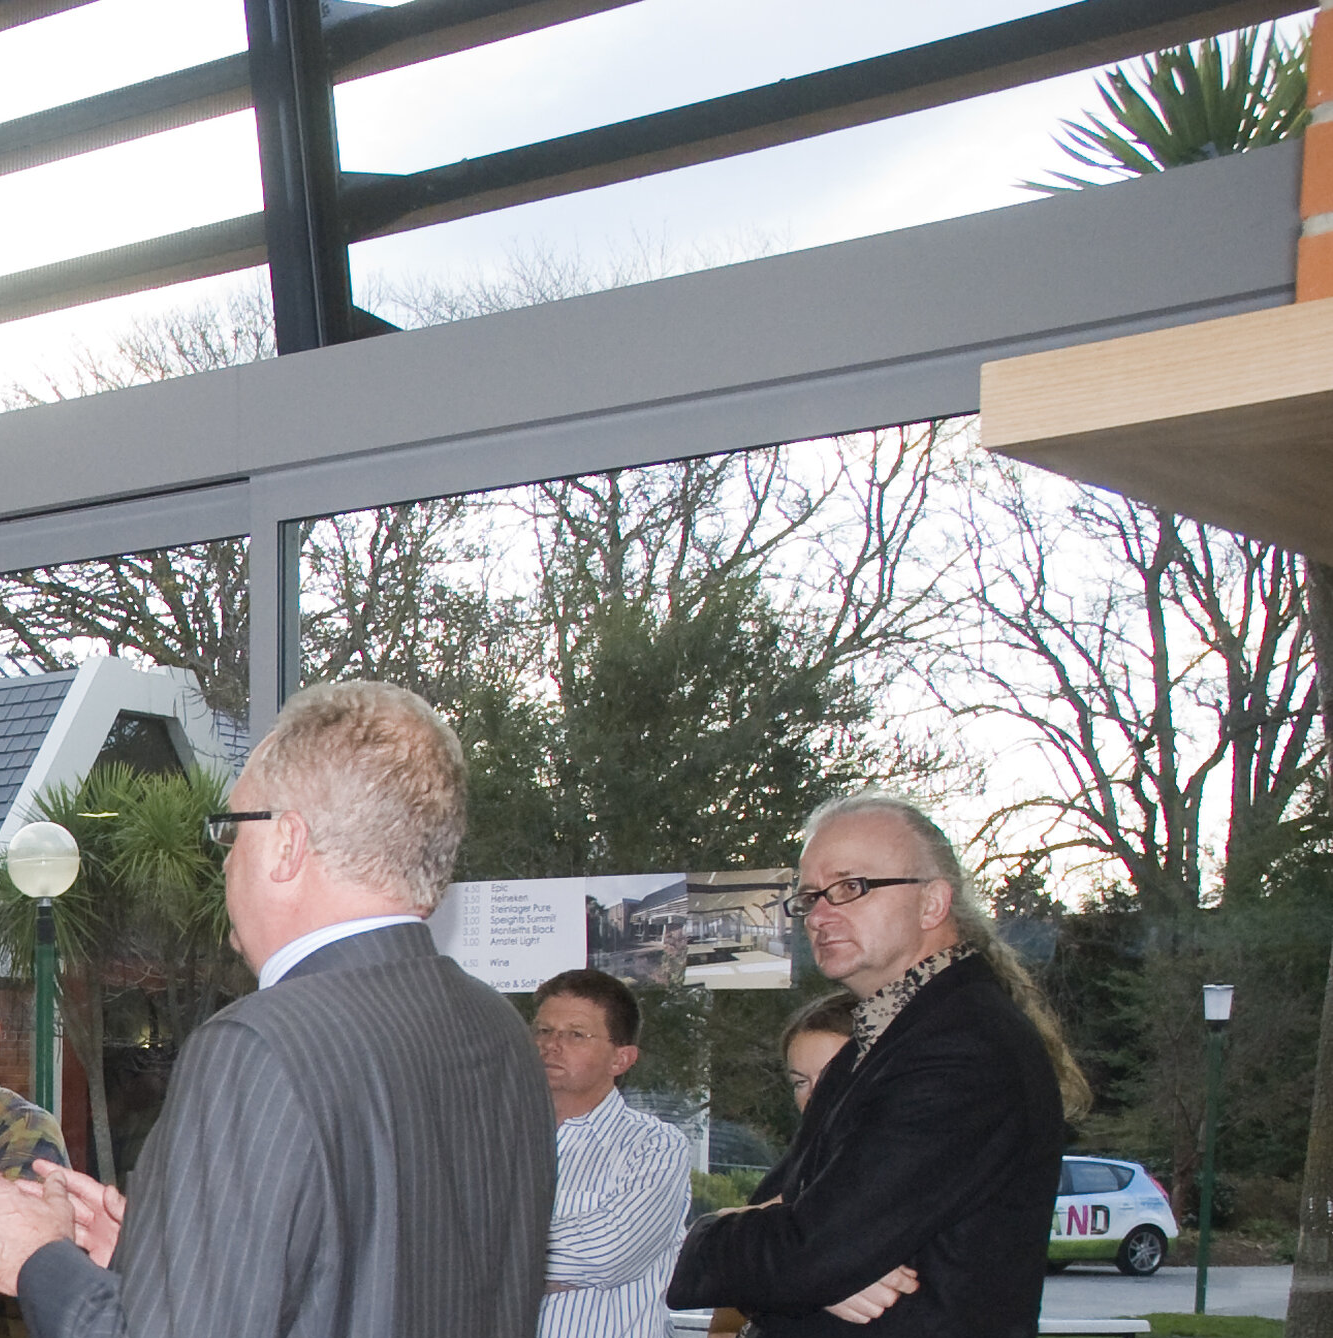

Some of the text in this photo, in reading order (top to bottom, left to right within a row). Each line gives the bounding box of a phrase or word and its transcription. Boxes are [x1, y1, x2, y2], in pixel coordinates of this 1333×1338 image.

[491, 884, 508, 894] Epic
[490, 894, 528, 903] Heineken
[490, 904, 531, 915] Steinlager
[533, 903, 551, 912] Pure
[532, 925, 555, 934] Black
[490, 938, 517, 946] Amstel
[519, 936, 540, 947] Light
